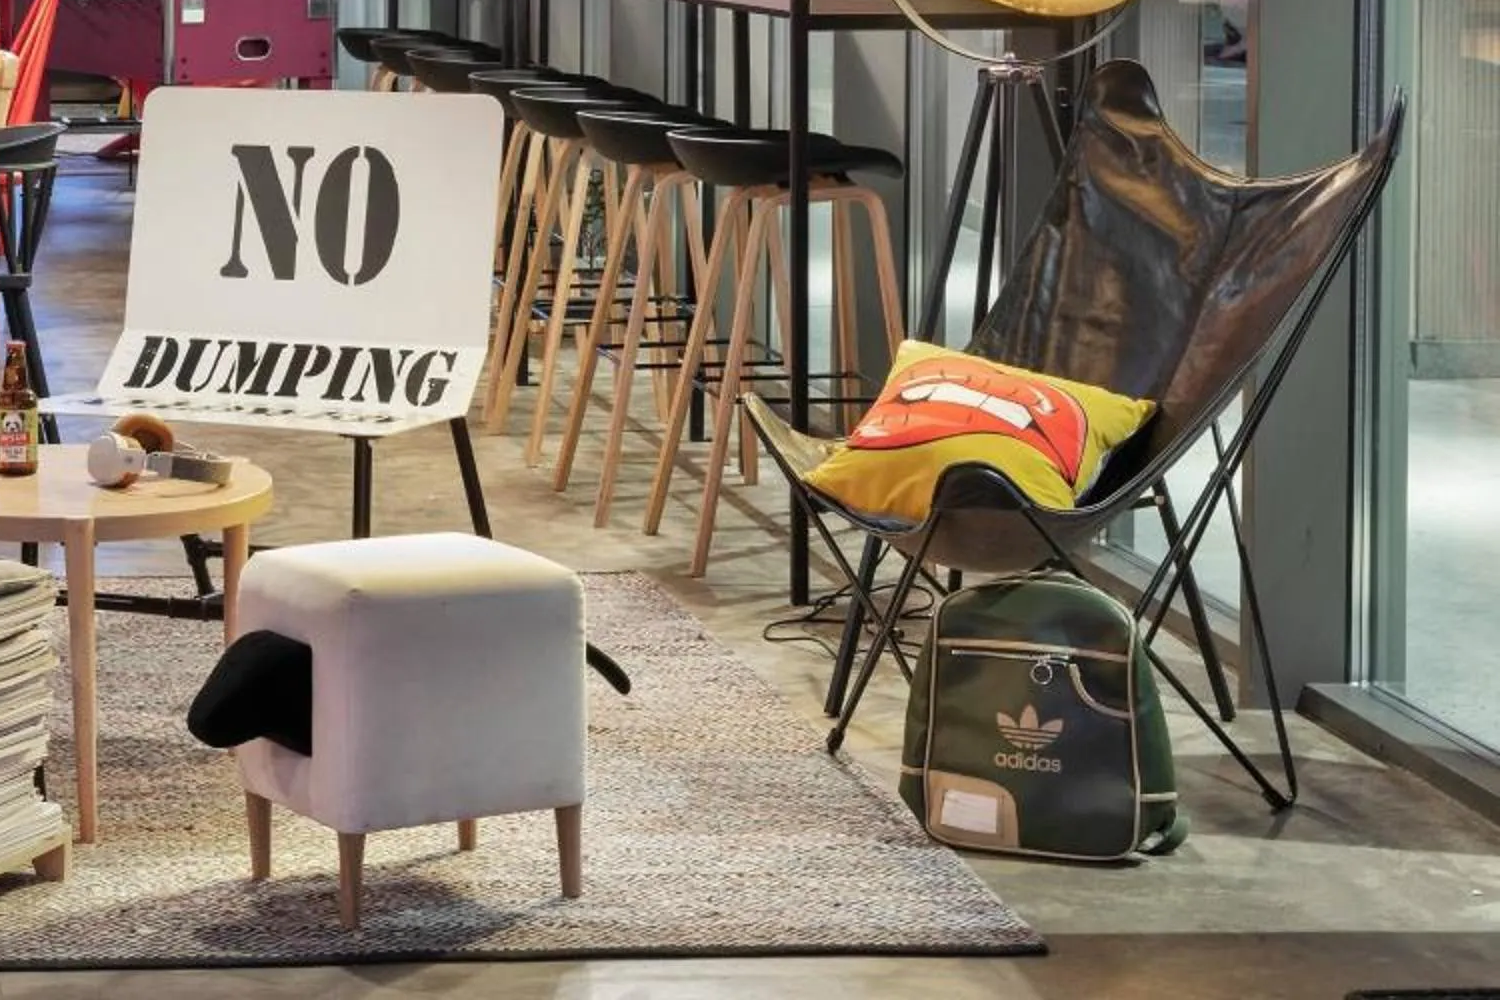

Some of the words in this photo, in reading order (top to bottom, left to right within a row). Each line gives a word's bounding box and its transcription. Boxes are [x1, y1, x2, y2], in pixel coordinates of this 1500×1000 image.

[219, 144, 400, 287] NO
[123, 335, 458, 408] DUMPING
[994, 751, 1062, 773] adidas
